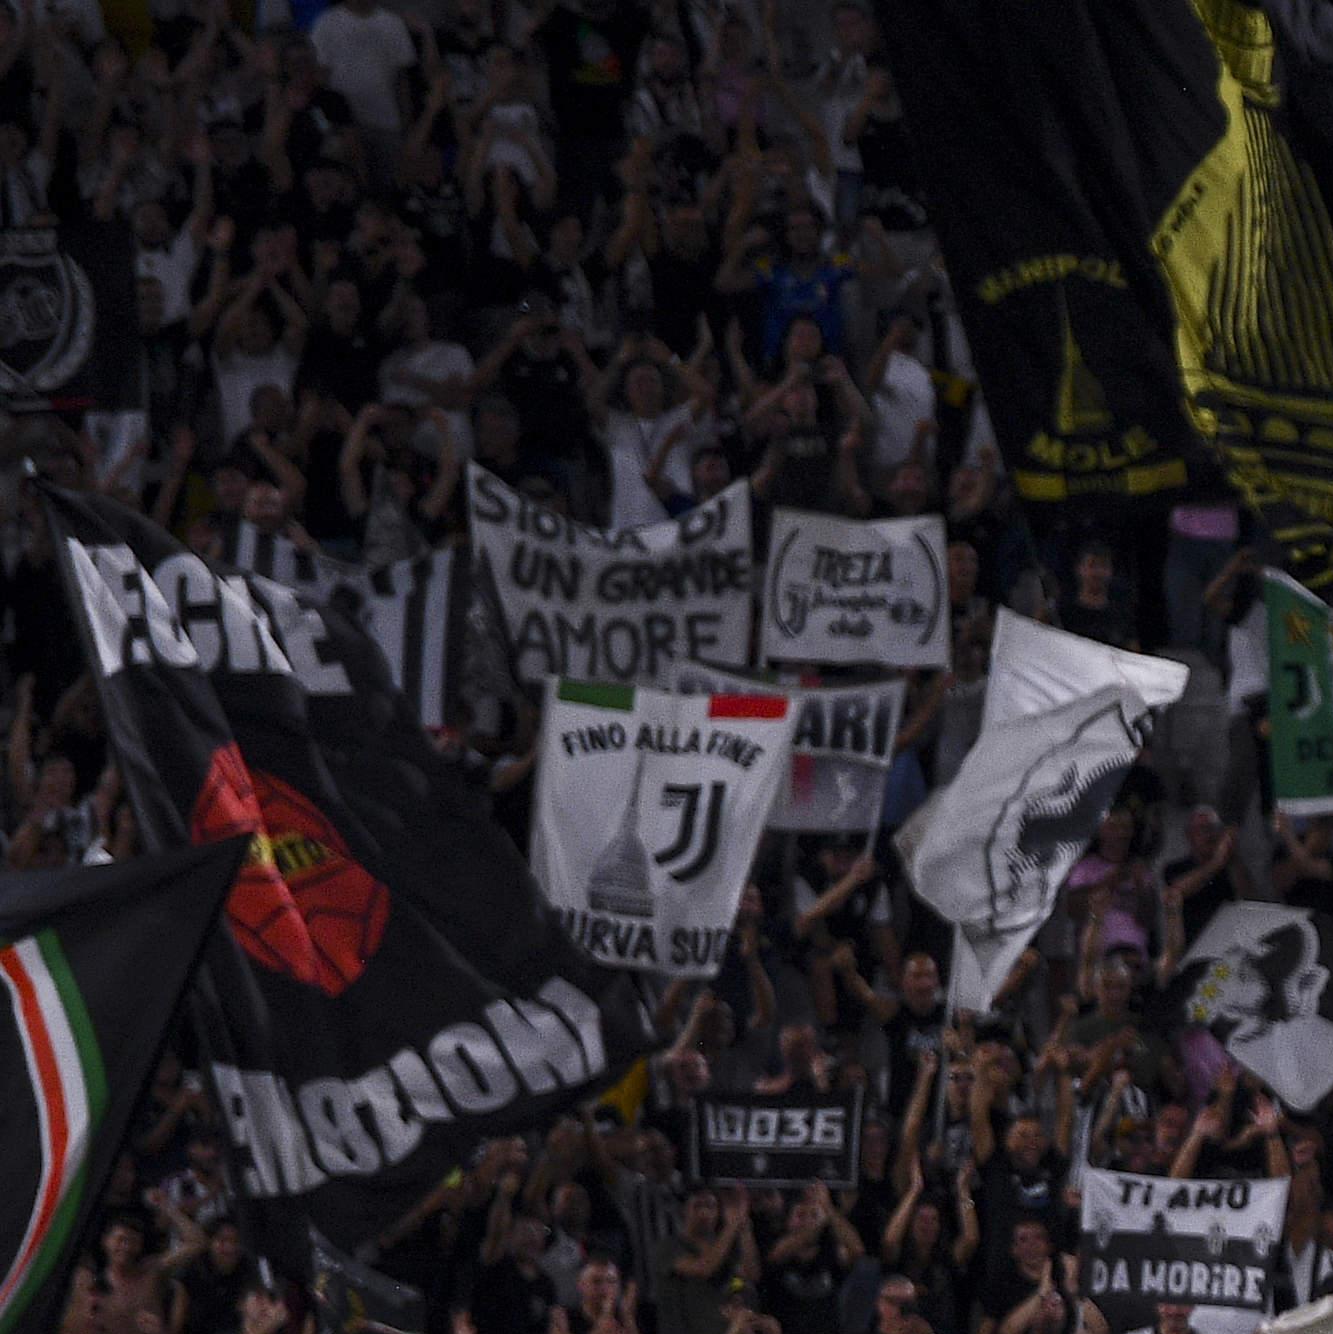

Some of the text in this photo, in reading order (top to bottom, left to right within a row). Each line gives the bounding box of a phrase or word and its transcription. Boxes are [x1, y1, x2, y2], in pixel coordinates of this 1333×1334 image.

[511, 541, 752, 605] UN GRANDE
[513, 609, 723, 682] AMORE
[561, 721, 766, 770] FINO ALLA FINE
[793, 696, 892, 759] ARI
[1165, 1180, 1252, 1213] AMO
[1092, 1259, 1131, 1293] DA
